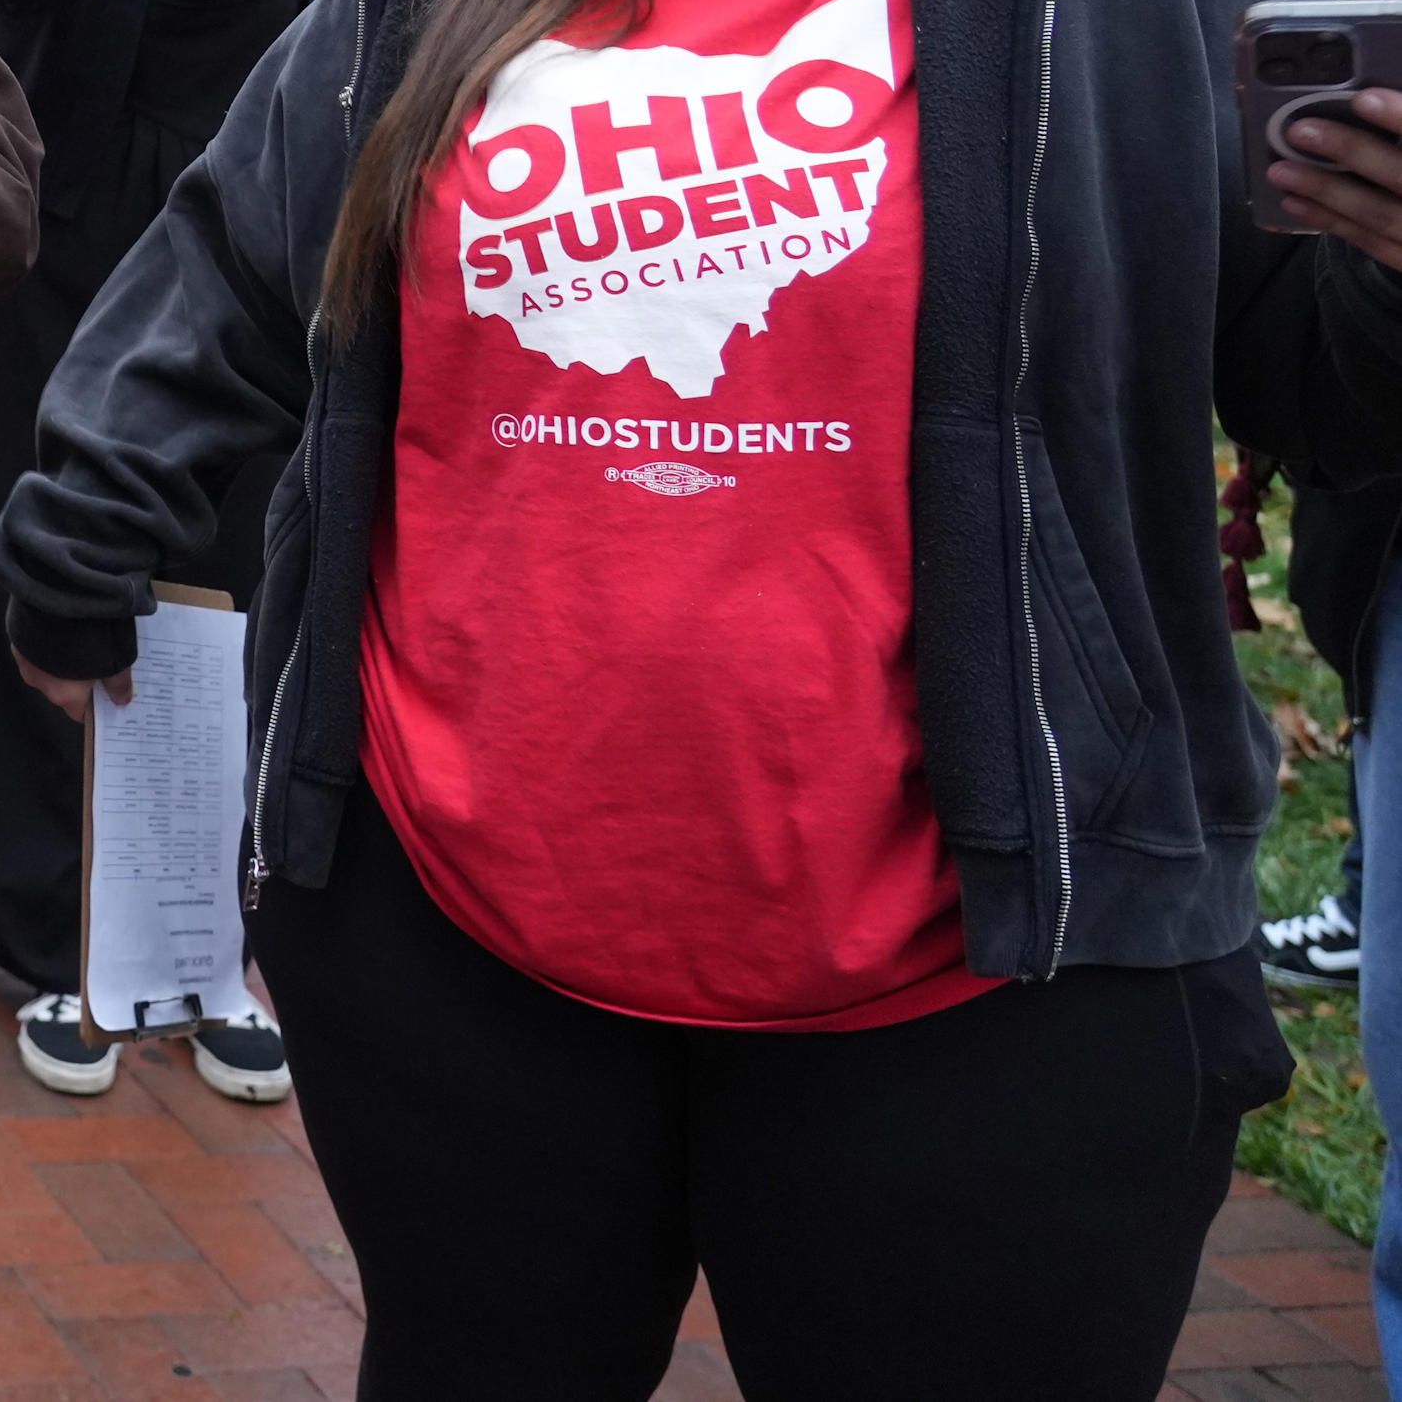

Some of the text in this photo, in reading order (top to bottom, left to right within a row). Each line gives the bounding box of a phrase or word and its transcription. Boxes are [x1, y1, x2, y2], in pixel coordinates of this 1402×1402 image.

[460, 59, 896, 220] OHIO
[466, 159, 870, 290] STUDENT
[521, 227, 852, 318] ASSOCIATION
[491, 413, 852, 453] @OHIOSTUDENTS
[668, 464, 700, 476] PRINTING
[722, 475, 736, 487] 10
